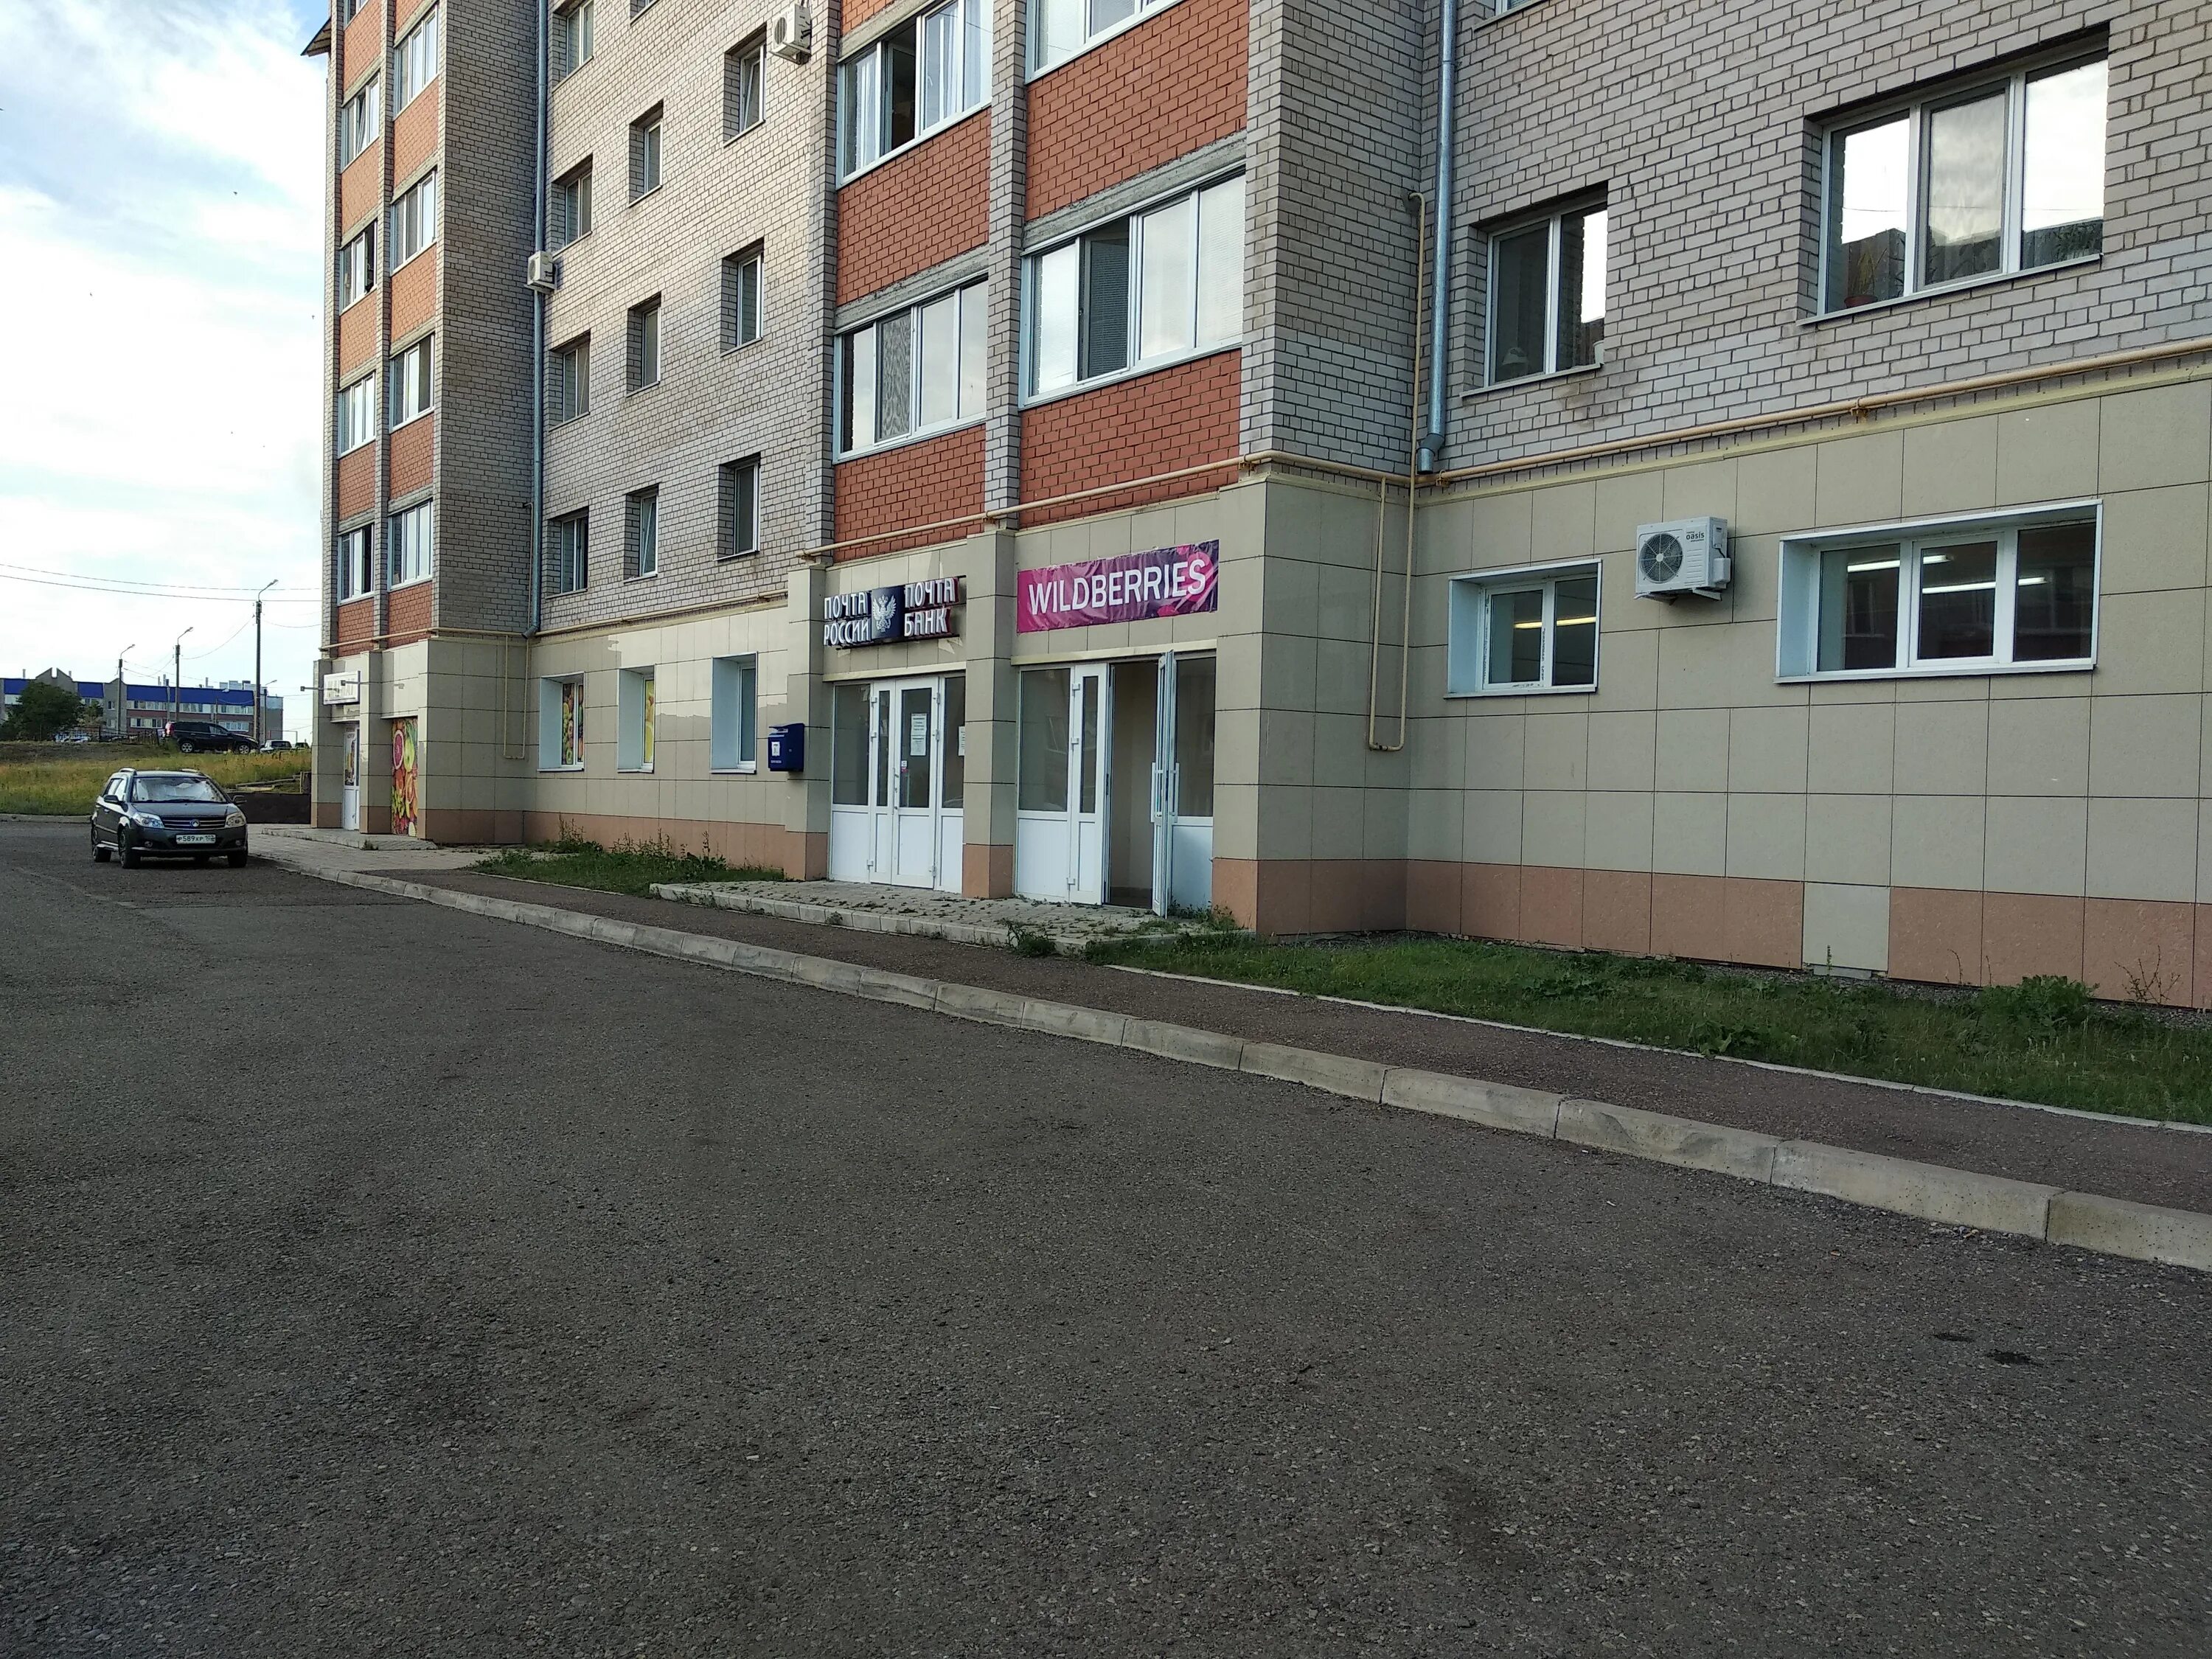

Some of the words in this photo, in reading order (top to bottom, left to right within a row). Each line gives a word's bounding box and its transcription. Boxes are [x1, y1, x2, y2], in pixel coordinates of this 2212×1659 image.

[1686, 531, 1705, 540] oasis
[904, 577, 956, 608] ПОЧТА
[1029, 559, 1206, 615] WILDBERRIES
[824, 591, 869, 620] ПОЧТА
[824, 619, 871, 646] РОССИИ
[904, 608, 949, 637] БАНК
